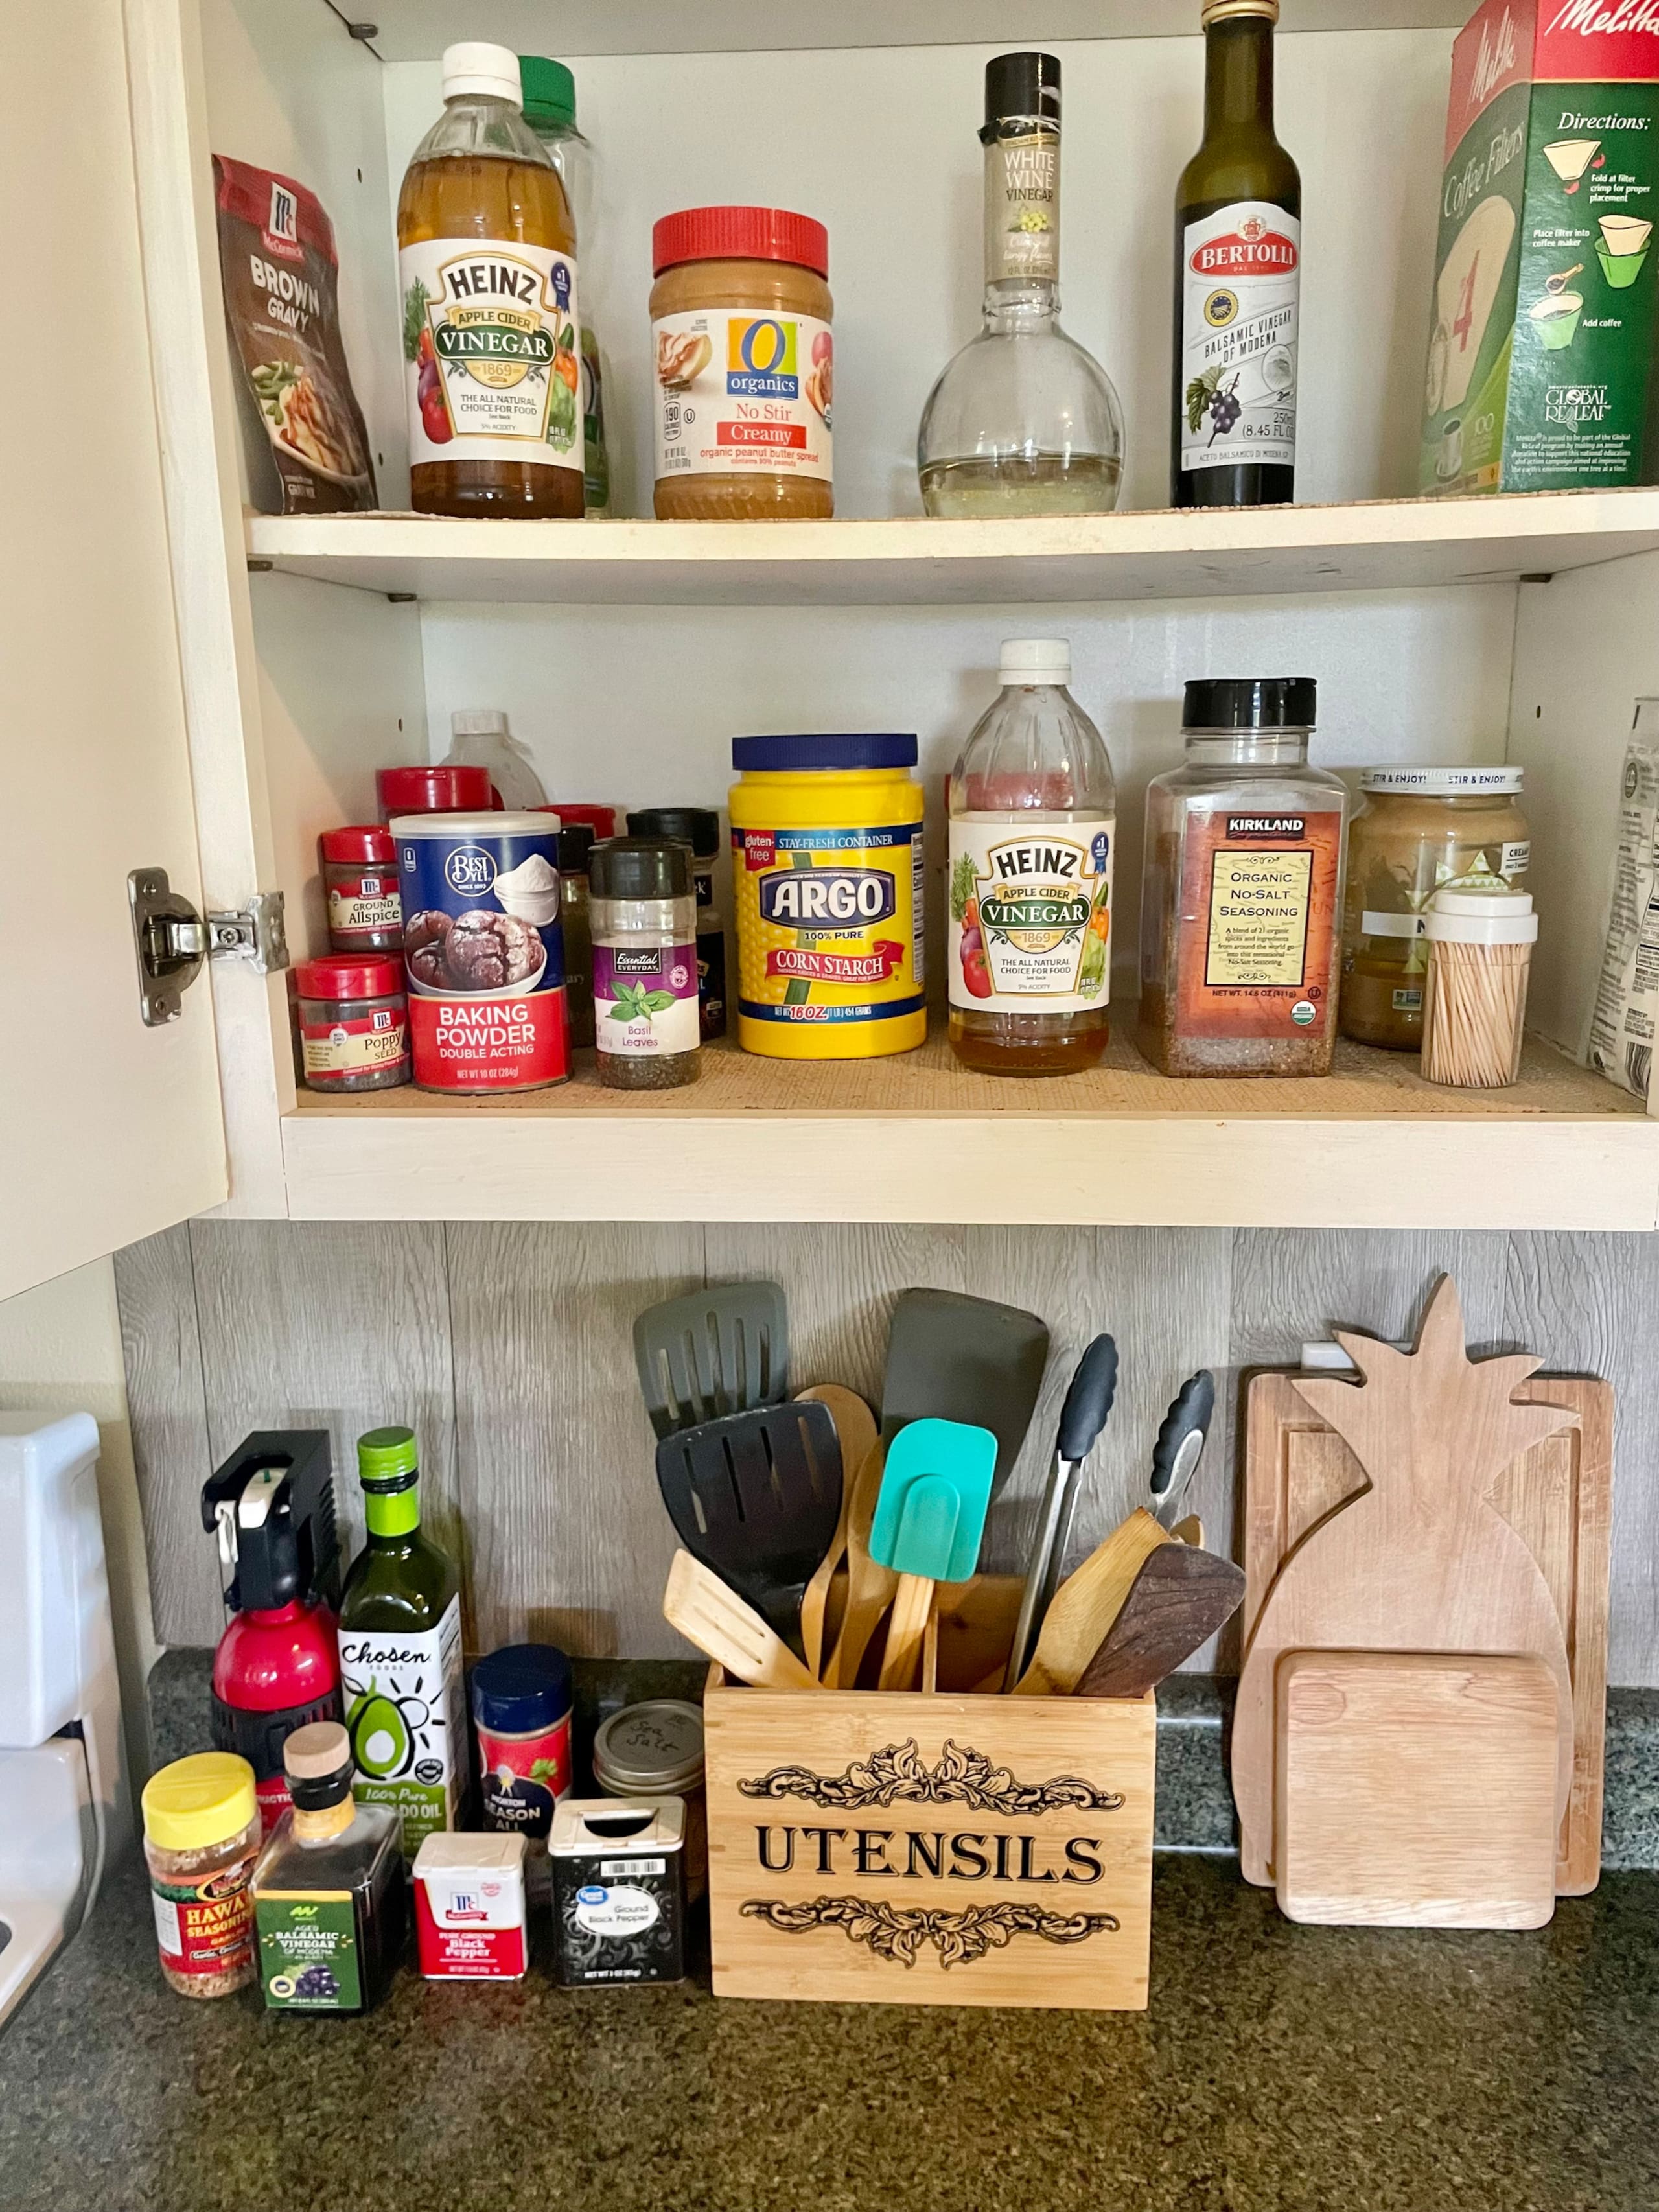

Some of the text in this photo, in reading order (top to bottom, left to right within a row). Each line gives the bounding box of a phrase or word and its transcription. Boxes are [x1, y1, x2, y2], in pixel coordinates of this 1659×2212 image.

[1557, 113, 1651, 130] Directions:
[1004, 150, 1055, 171] WHITE
[1006, 170, 1053, 190] WINE
[1006, 188, 1054, 202] VINEGAR
[1590, 184, 1612, 194] crimp
[1626, 185, 1651, 194] proper
[1590, 194, 1628, 203] placement
[1533, 239, 1555, 247] coffee
[1201, 244, 1294, 269] BERTOLLI
[250, 255, 320, 317] BROWN
[447, 265, 537, 305] HEINZ
[268, 297, 309, 333] GRAVY
[458, 311, 531, 329] APPLE CIDER
[1205, 310, 1292, 358] BALSAMIC VINEGAR
[441, 332, 549, 357] VINEGAR
[1223, 331, 1277, 363] OF MODENA
[481, 362, 513, 376] 1869
[730, 377, 795, 393] organics
[461, 394, 537, 406] THE ALL NATURAL
[1545, 390, 1607, 405] GLOBAL
[461, 404, 537, 415] CHOICE FOR FOOD
[736, 403, 792, 421] No Stir
[730, 425, 792, 444] Creamy
[1273, 425, 1284, 437] FL
[700, 448, 733, 458] organic
[735, 448, 768, 460] peanut
[769, 447, 795, 459] butter
[796, 452, 818, 463] spread
[1395, 774, 1426, 784] ENJOY!
[1479, 776, 1506, 784] ENJOY!
[1229, 818, 1303, 832] KIRKLAND
[745, 835, 774, 848] gluten-
[778, 835, 893, 849] STAY-FRESH CONTAINER
[749, 848, 769, 861] free
[452, 855, 487, 883] BEST
[996, 848, 1078, 879] HEINZ
[470, 870, 488, 882] YET
[772, 878, 884, 919] ARGO
[1003, 887, 1070, 900] APPLE CIDER
[353, 900, 393, 911] GROUND
[986, 904, 1084, 922] VINEGAR
[349, 909, 400, 926] Allspice
[805, 931, 864, 940] 100% PURE
[1021, 932, 1050, 943] 1869
[617, 952, 657, 966] Essential
[776, 950, 883, 975] CORN STARCH
[439, 1003, 529, 1025] BAKING
[790, 1005, 804, 1019] 16
[805, 1005, 828, 1019] OZ.
[435, 1023, 536, 1047] POWDER
[627, 1025, 651, 1036] Basil
[622, 1037, 658, 1047] Leaves
[375, 1047, 397, 1060] SEED
[439, 1044, 535, 1059] DOUBLE ACTING
[456, 1069, 467, 1079] NET
[468, 1069, 478, 1079] WT
[480, 1069, 487, 1078] 10
[489, 1069, 498, 1078] OZ
[342, 1641, 430, 1664] Chosen
[398, 1787, 428, 1802] Pure
[420, 1803, 443, 1819] OIL
[754, 1825, 1106, 1885] UTENSILS
[275, 1932, 339, 1940] BALSAMIC
[449, 1939, 485, 1948] Black
[445, 1947, 491, 1959] Pepper
